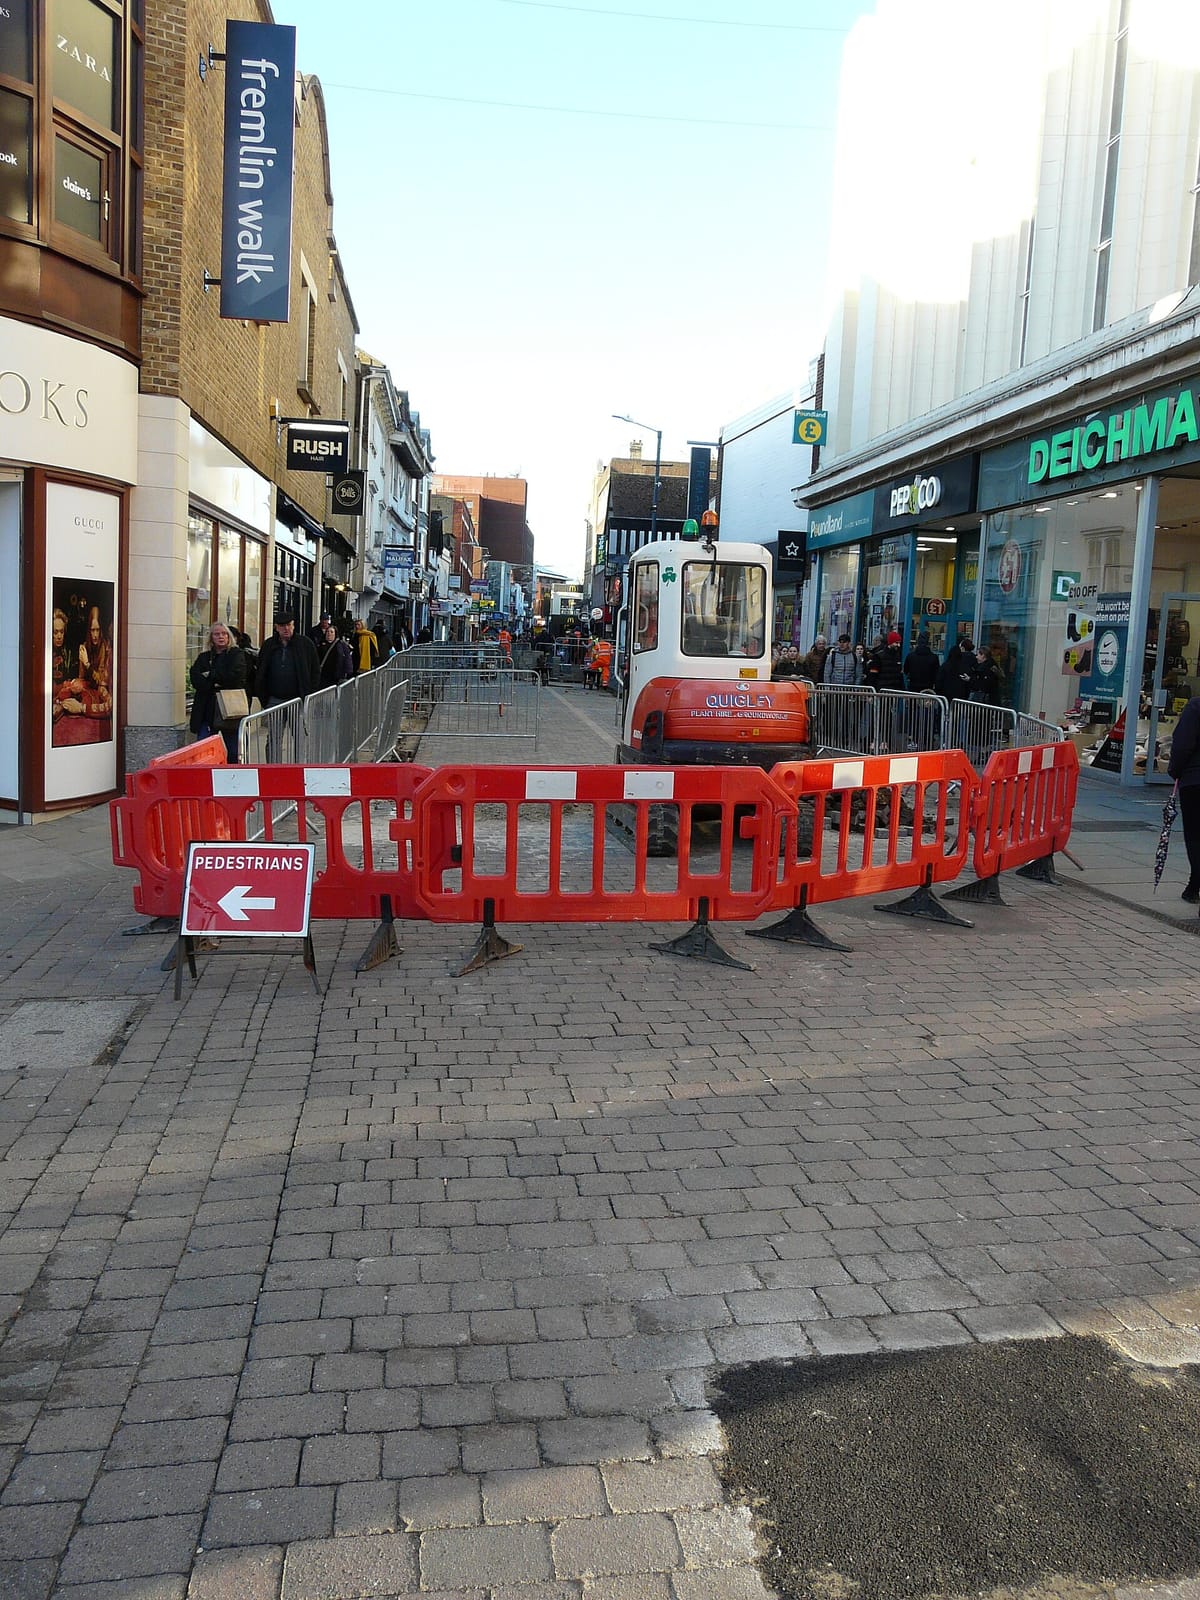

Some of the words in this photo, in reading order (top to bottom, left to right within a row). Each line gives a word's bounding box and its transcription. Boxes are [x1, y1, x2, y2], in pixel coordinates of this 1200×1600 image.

[56, 34, 112, 83] ZARA
[238, 58, 280, 189] fremlin
[62, 176, 92, 201] claire's
[236, 199, 275, 284] walk
[0, 371, 88, 428] OKS
[796, 410, 827, 418] Poundland
[1028, 390, 1199, 484] DEICHMA
[293, 439, 343, 456] RUSH
[74, 516, 104, 530] GUCCI
[810, 511, 843, 539] Poundland
[1082, 585, 1098, 597] OFF
[928, 603, 943, 613] £1
[1105, 601, 1121, 611] won't
[1121, 600, 1130, 611] be
[1109, 614, 1117, 622] on
[706, 694, 775, 708] QUIGLEY
[194, 856, 303, 871] PEDESTRIANS
